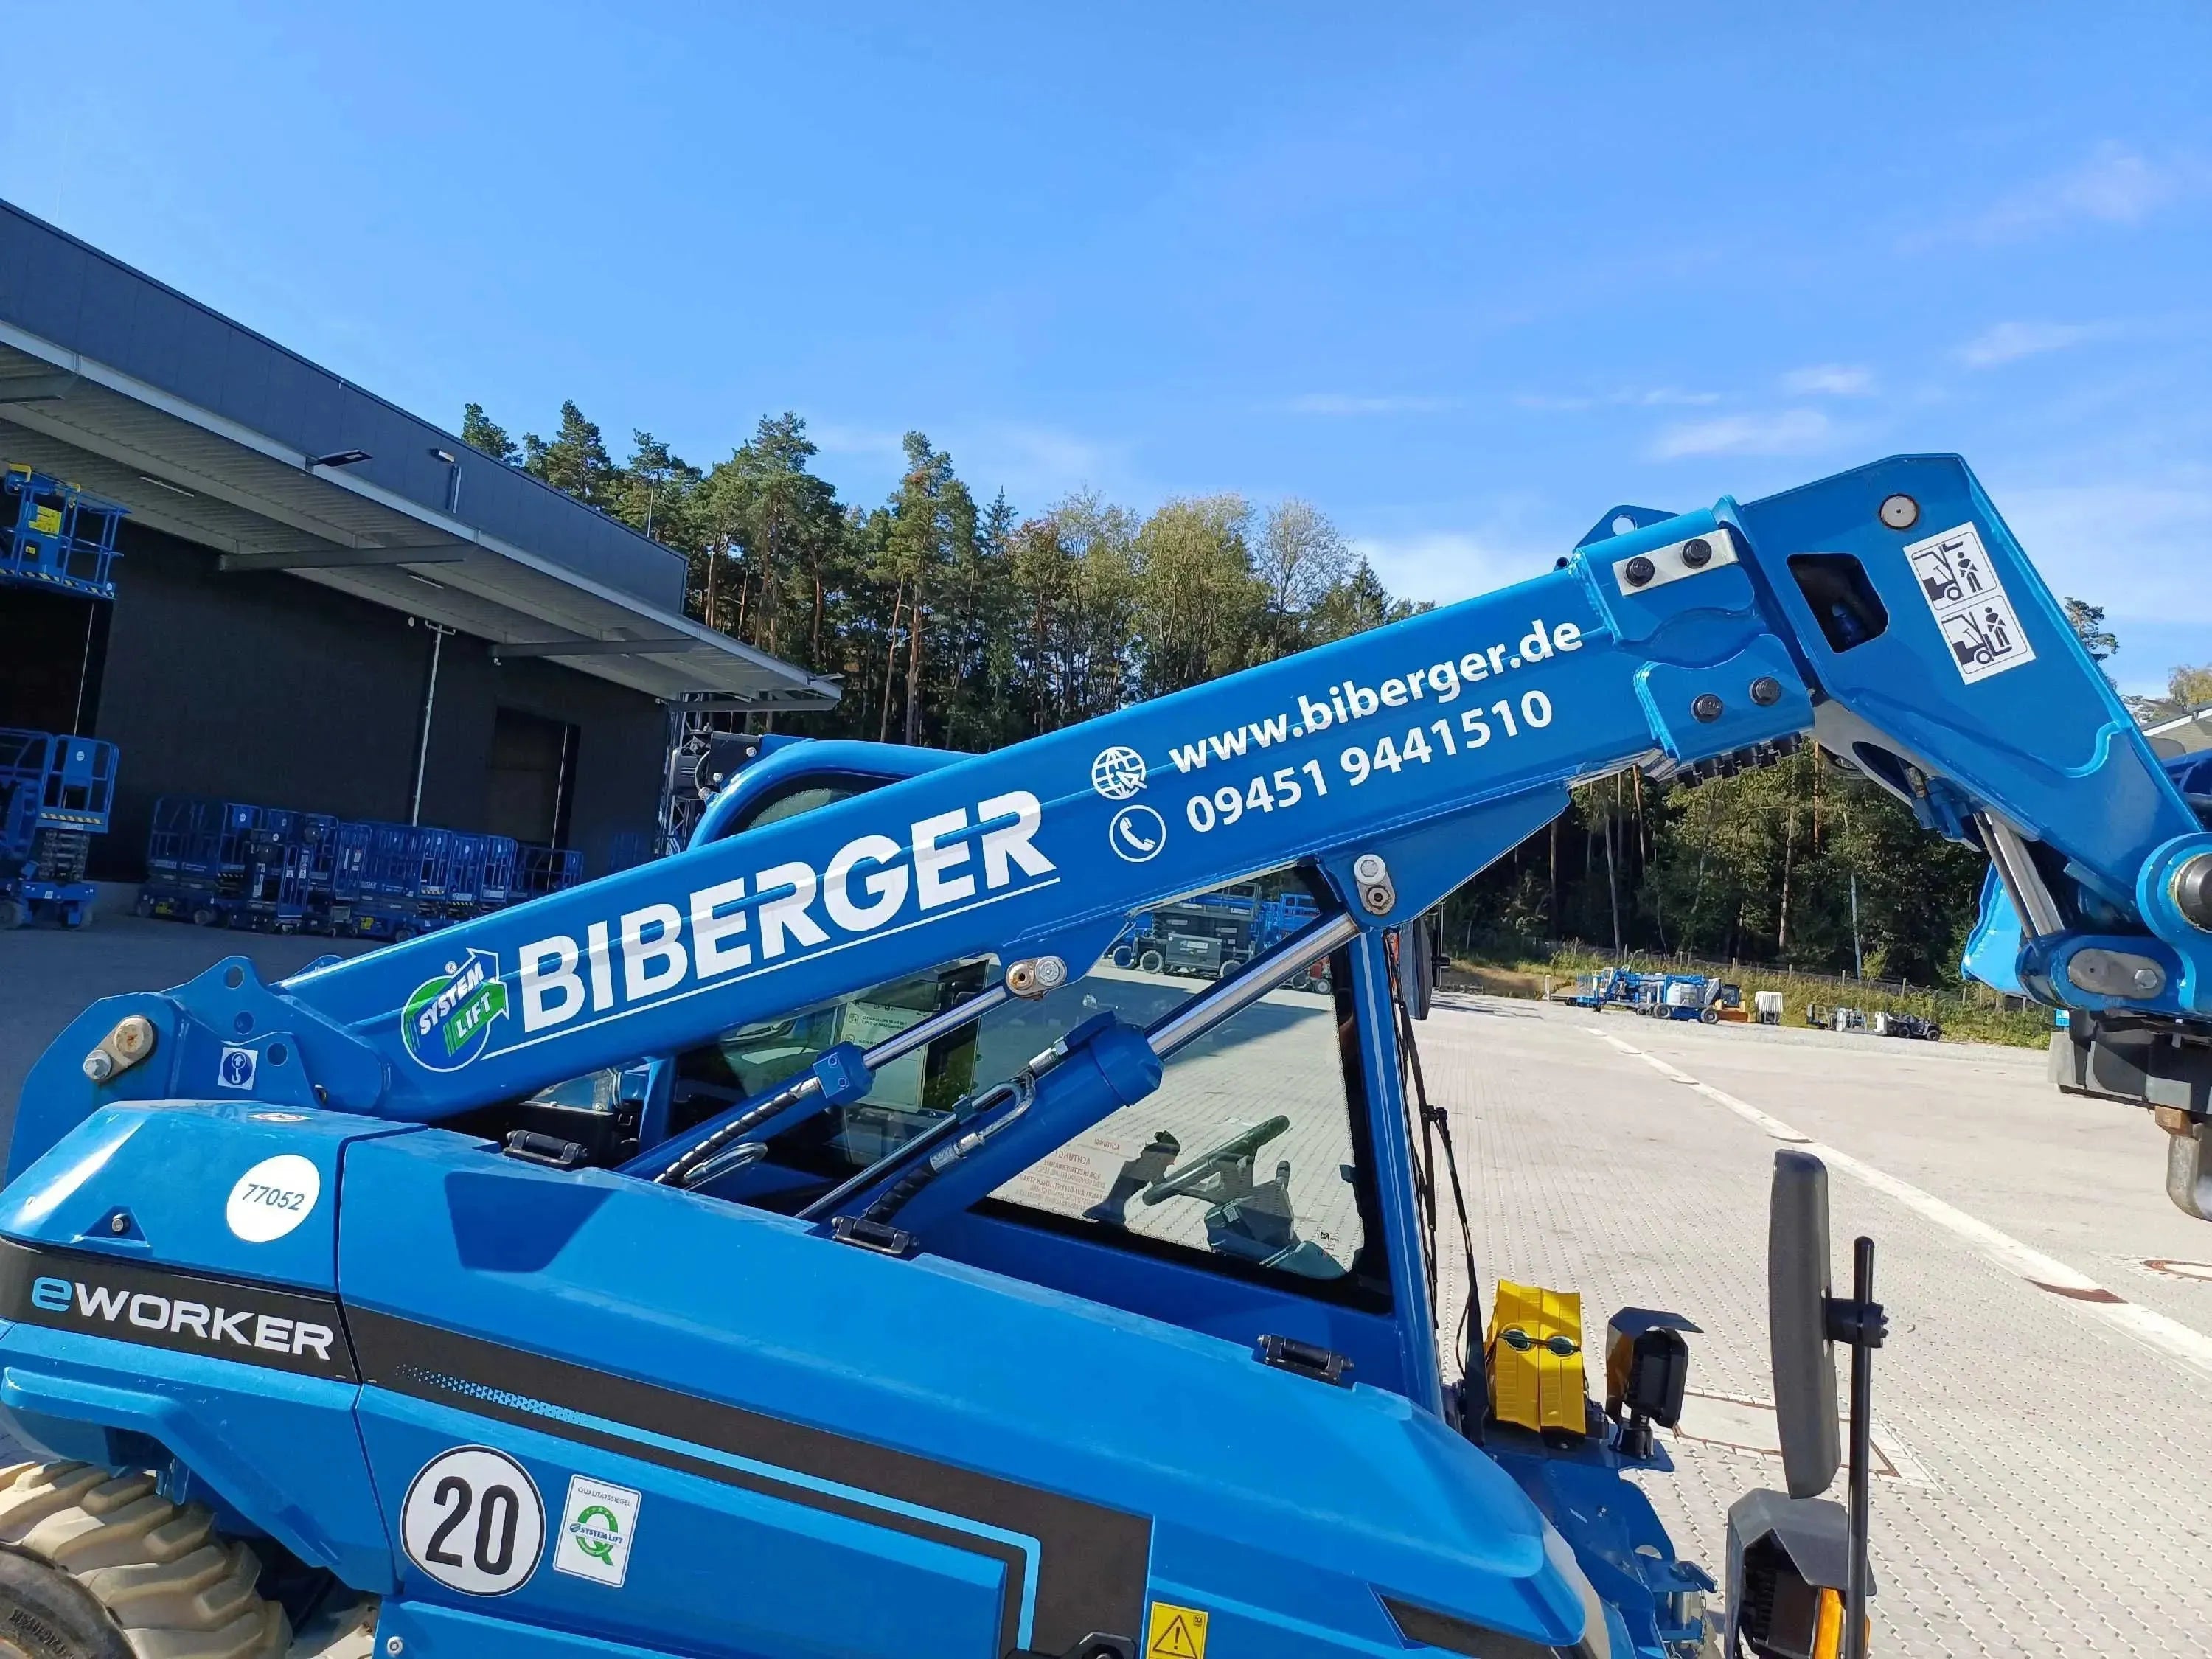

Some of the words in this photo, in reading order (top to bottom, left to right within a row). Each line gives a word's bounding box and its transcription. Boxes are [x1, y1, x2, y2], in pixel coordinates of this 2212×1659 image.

[1168, 619, 1584, 774] www.biberger.de
[1186, 759, 1328, 834] 09451
[1340, 690, 1553, 787] 9441510
[518, 790, 1057, 1032] BIBERGER
[419, 961, 484, 1035] SYSTEM
[456, 991, 491, 1039] LIFT
[241, 1183, 305, 1211] 77052
[32, 1276, 333, 1360] eWORKER
[425, 1475, 519, 1576] 20
[580, 1527, 608, 1541] SYSTEM
[608, 1534, 623, 1544] LIFT
